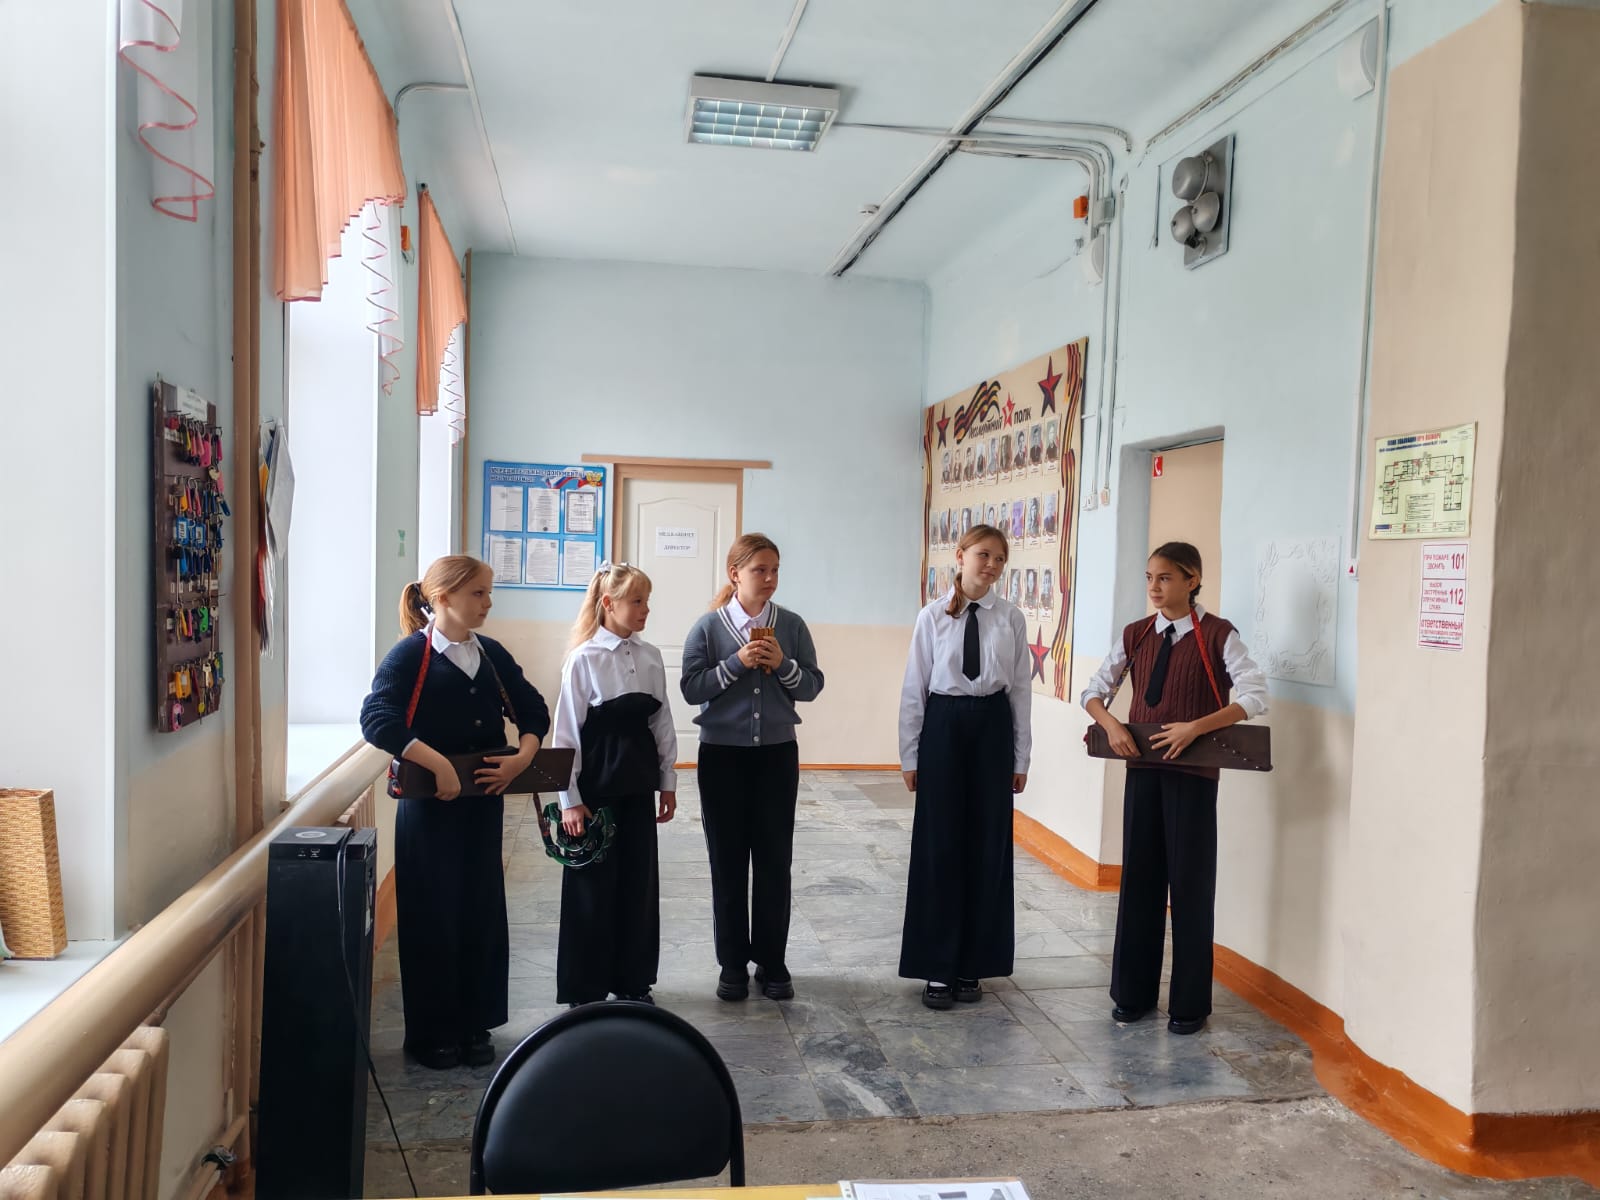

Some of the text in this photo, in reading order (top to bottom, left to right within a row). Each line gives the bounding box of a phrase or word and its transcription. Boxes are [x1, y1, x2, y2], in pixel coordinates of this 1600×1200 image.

[1433, 553, 1449, 561] ПОЖАРЕ
[1451, 553, 1465, 570] 101
[1449, 588, 1464, 605] 112
[1420, 619, 1463, 630] ОТВЕТСТВЕННЫЙ
